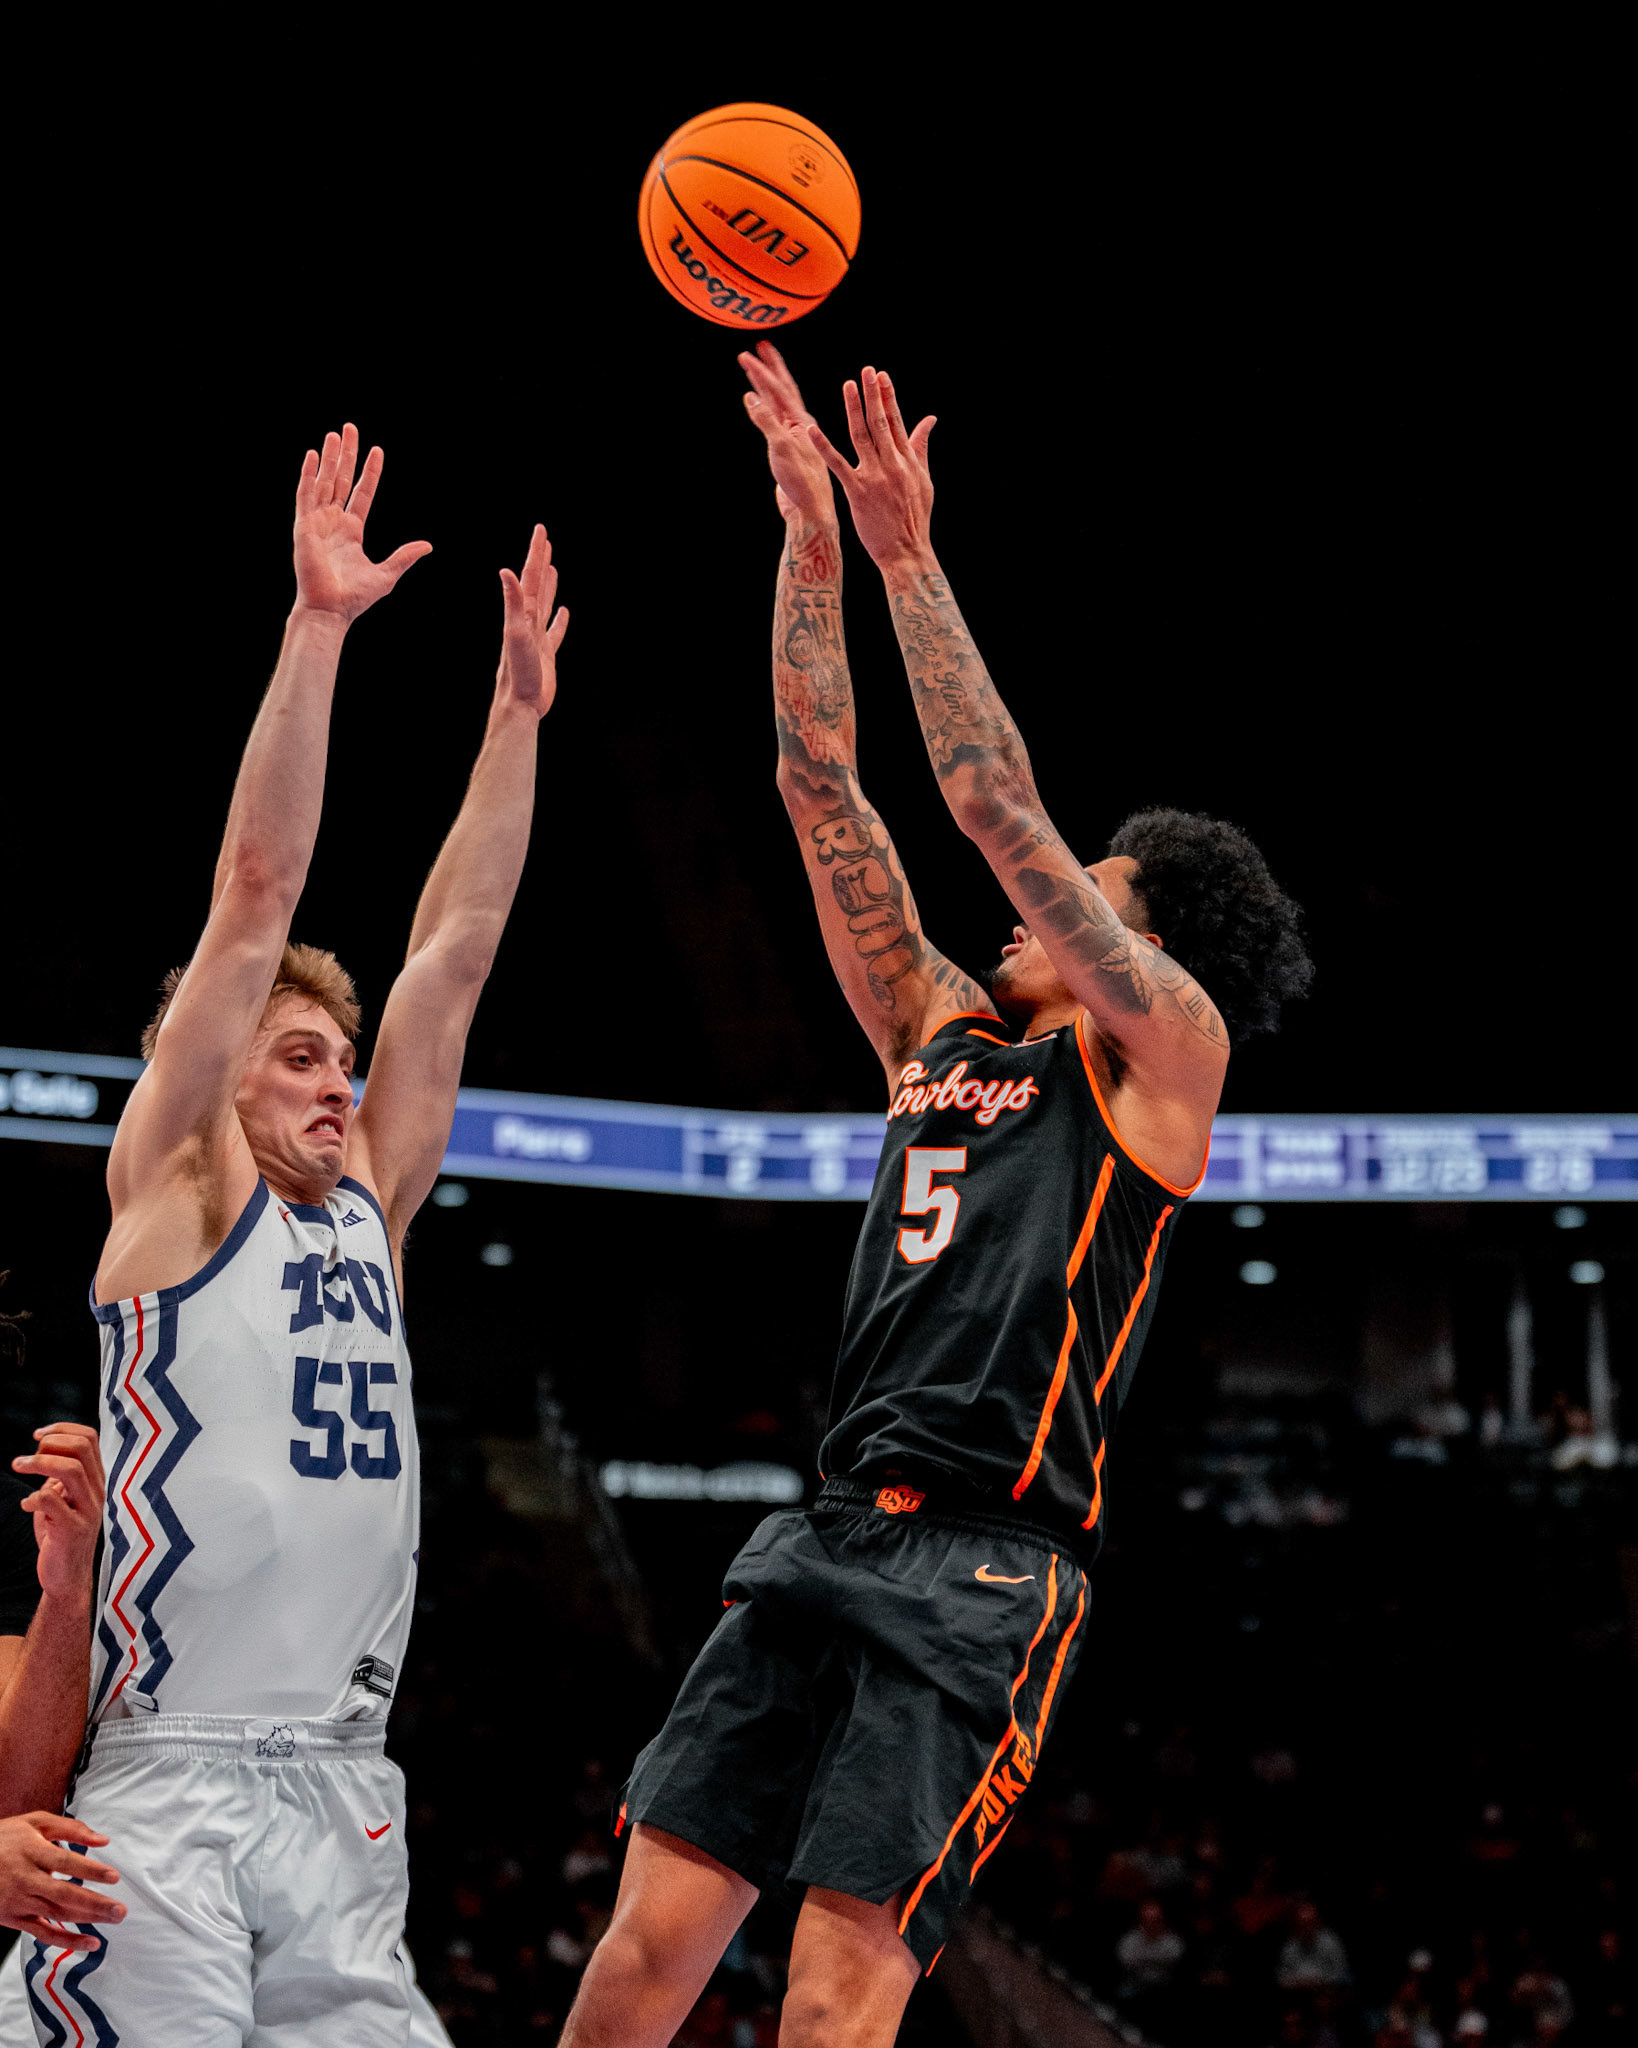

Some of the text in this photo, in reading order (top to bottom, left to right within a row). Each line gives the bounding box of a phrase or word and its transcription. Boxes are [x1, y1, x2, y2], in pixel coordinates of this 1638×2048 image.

[669, 223, 790, 323] Wilson
[887, 1060, 1039, 1125] Cowboys
[897, 1146, 967, 1264] 5
[281, 1253, 392, 1336] TCU
[290, 1356, 402, 1480] 55
[875, 1485, 926, 1514] OSU
